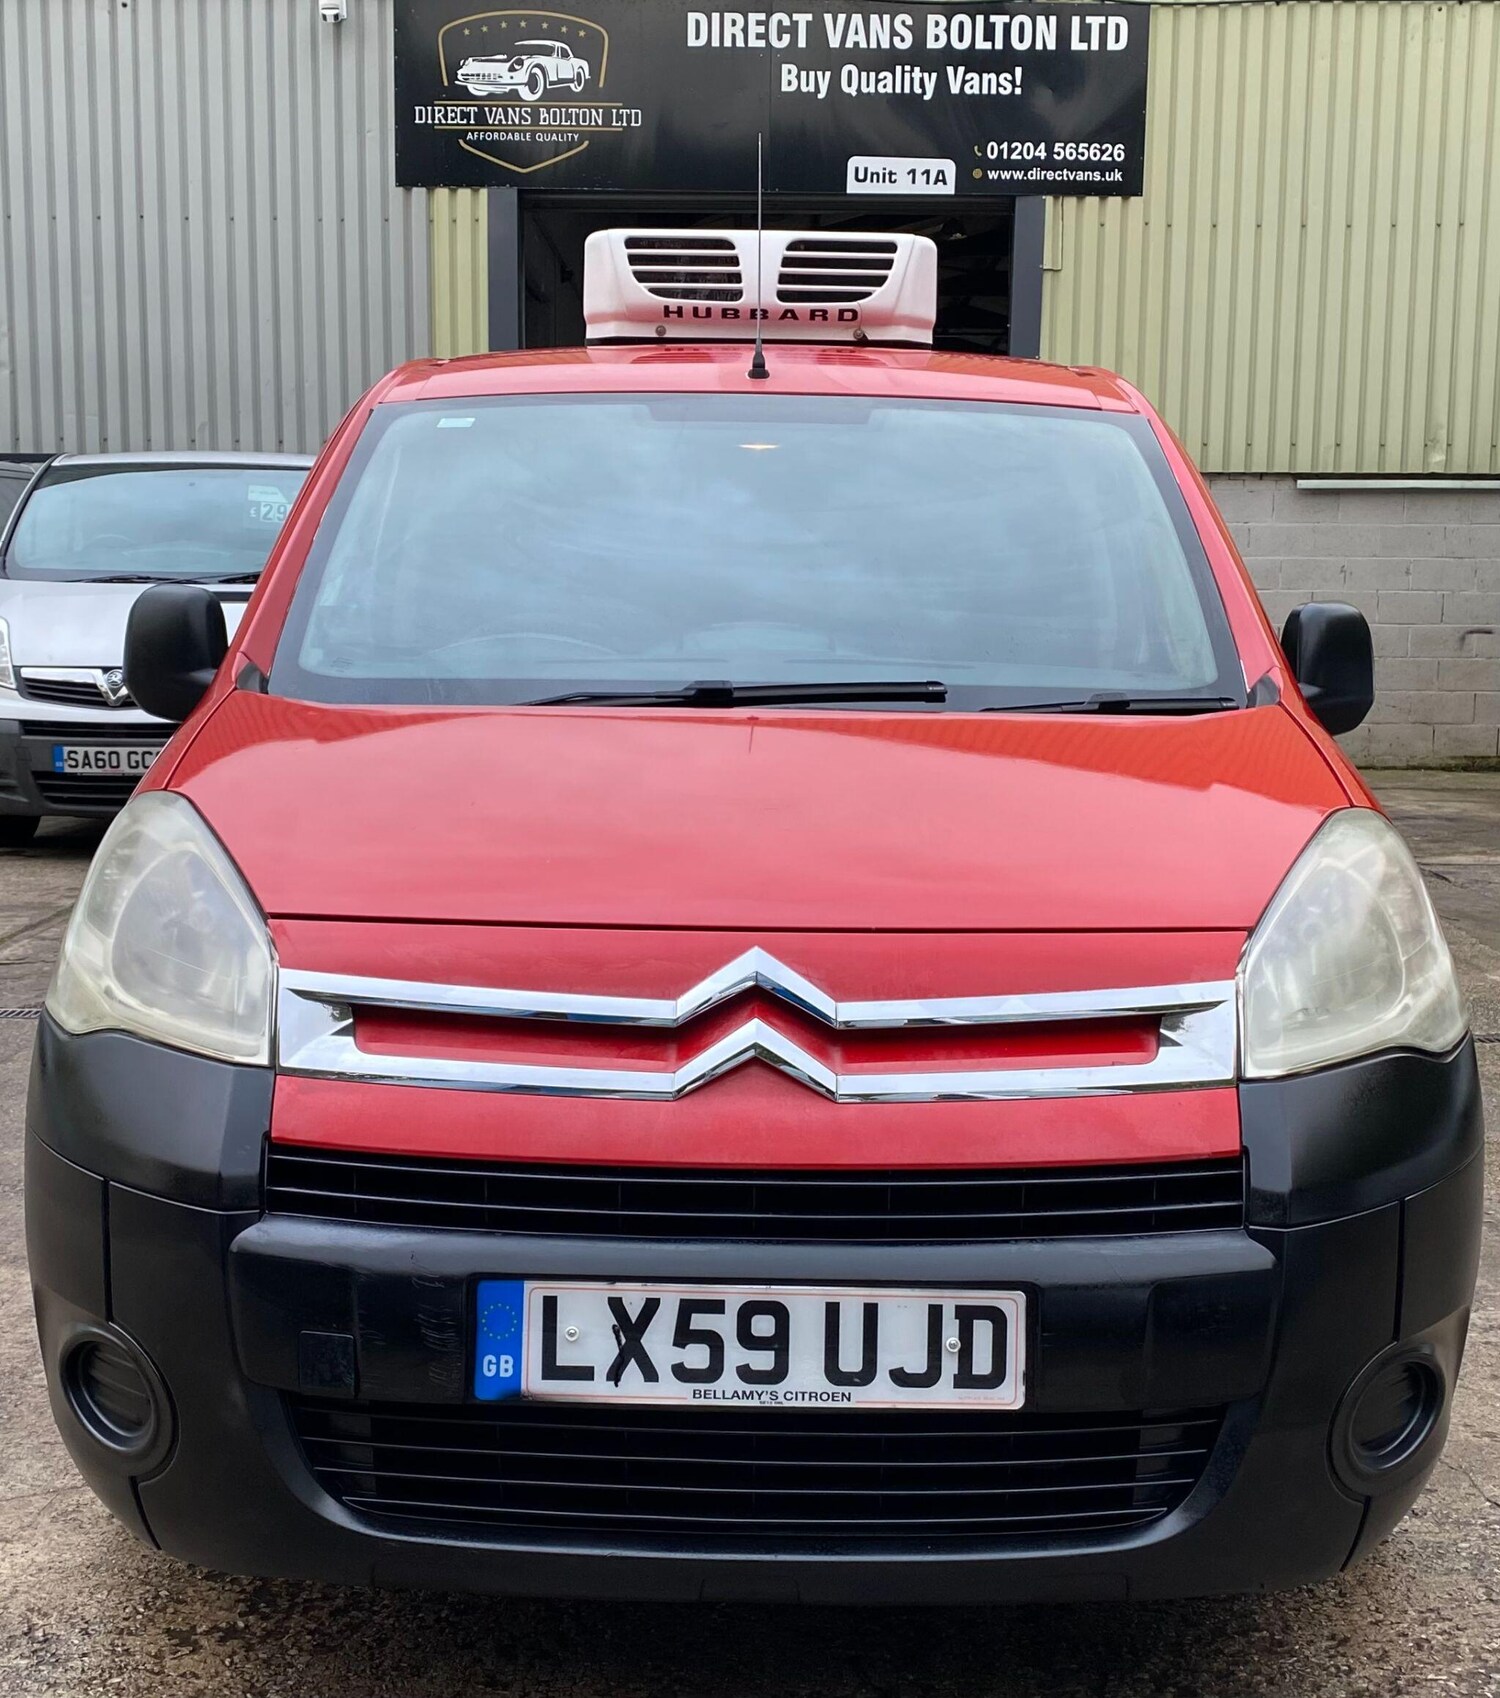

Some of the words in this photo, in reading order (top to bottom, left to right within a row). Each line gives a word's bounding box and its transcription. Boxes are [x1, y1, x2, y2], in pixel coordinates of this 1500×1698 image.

[687, 12, 813, 48] DIRECT
[824, 13, 914, 50] VANS
[925, 14, 1058, 51] BOLTON
[1070, 15, 1129, 51] LTD
[780, 64, 831, 99] Buy
[840, 64, 938, 101] Quality
[946, 66, 1023, 95] Vans!
[414, 105, 478, 125] DIRECT
[484, 107, 531, 125] VANS
[538, 108, 602, 126] BOLTON
[611, 109, 642, 127] LTD
[466, 131, 531, 142] AFFORDABLE
[535, 132, 579, 142] QUALITY
[986, 141, 1047, 160] 01204
[1053, 142, 1125, 161] 565626
[854, 166, 897, 184] Unit
[907, 168, 948, 186] 11A
[987, 167, 1123, 182] www.directvans.uk
[663, 305, 859, 322] HUBBARD
[66, 750, 121, 769] SA60
[127, 750, 161, 769] GC
[541, 1295, 791, 1387] LX59
[824, 1301, 1008, 1390] UJD
[482, 1354, 514, 1378] GB
[783, 1391, 852, 1402] CITROEN
